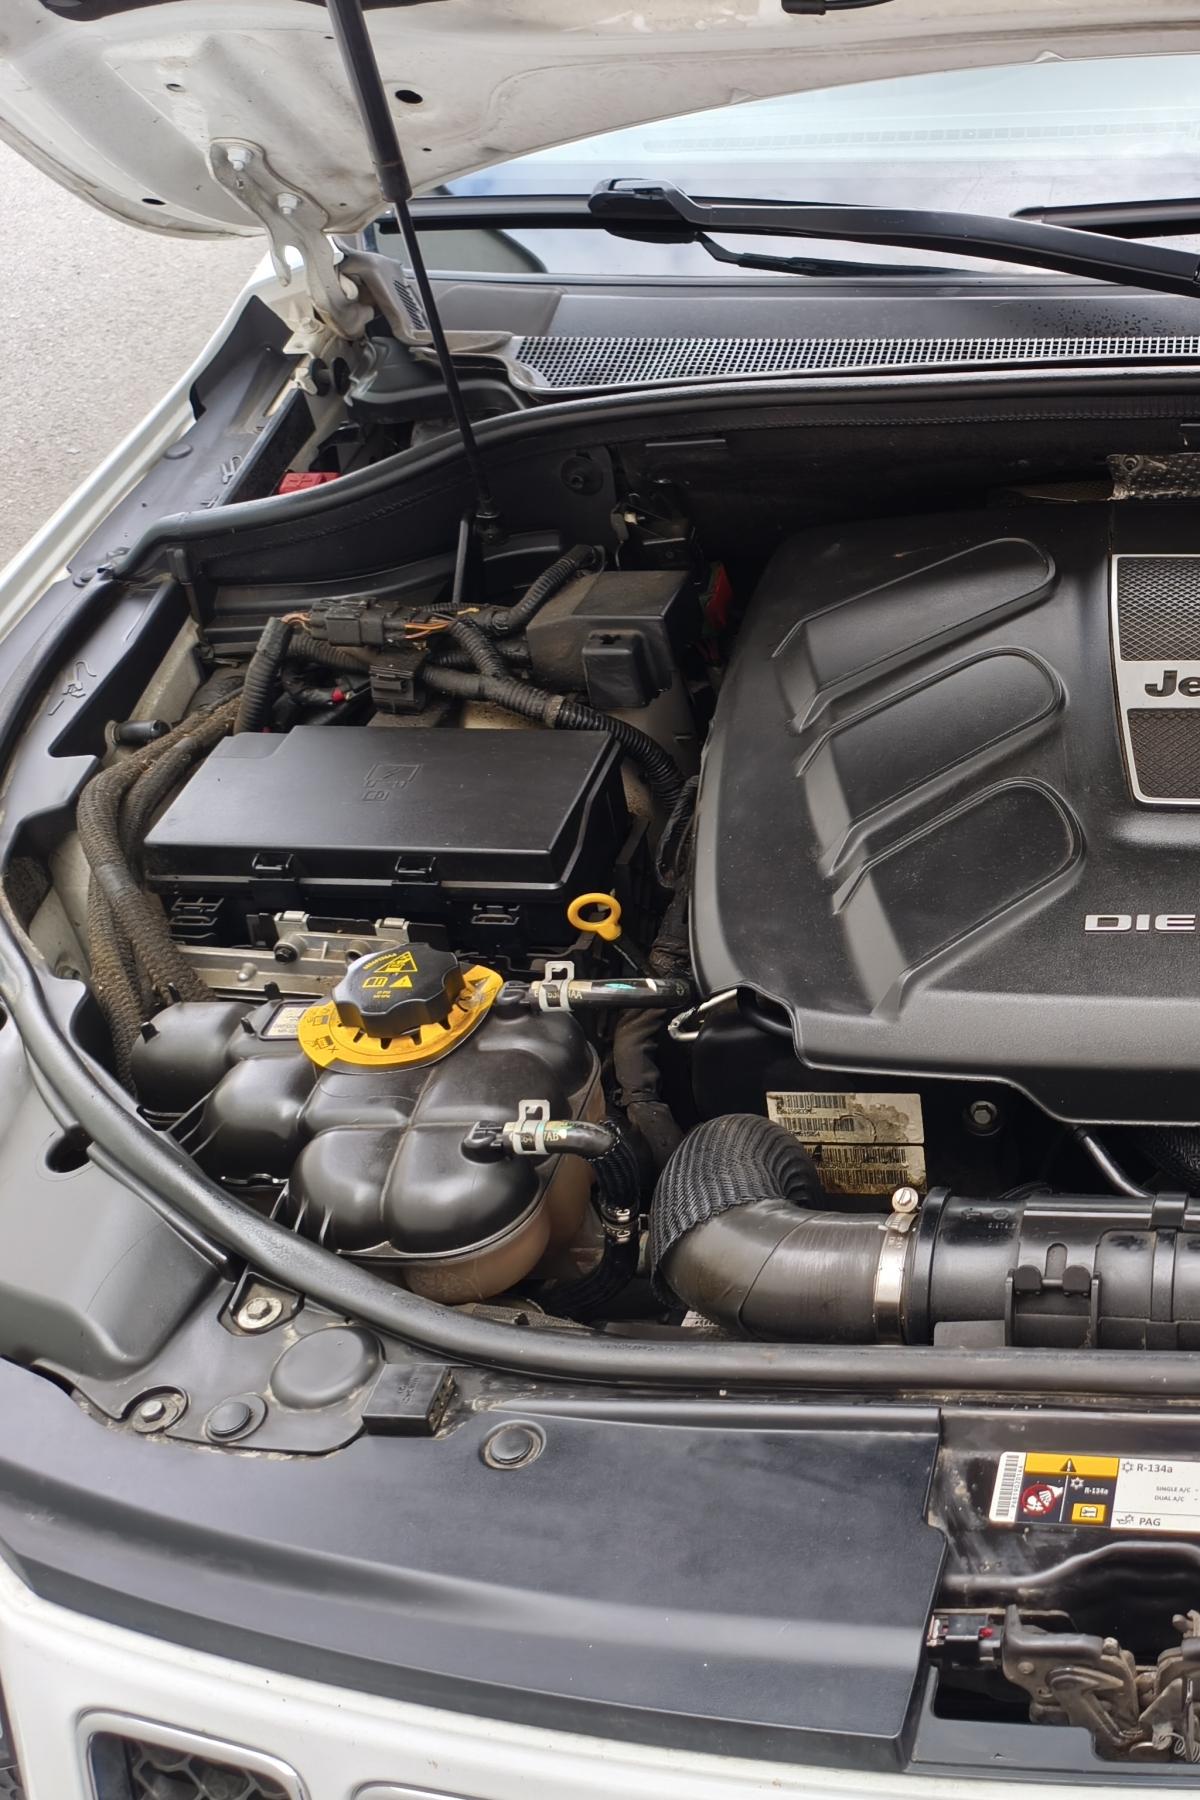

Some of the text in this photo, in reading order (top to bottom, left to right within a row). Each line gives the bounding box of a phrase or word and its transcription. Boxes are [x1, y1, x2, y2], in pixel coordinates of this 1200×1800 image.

[1136, 1463, 1173, 1473] R-134a
[1084, 1487, 1109, 1495] R-134a
[1139, 1517, 1161, 1527] PAG
